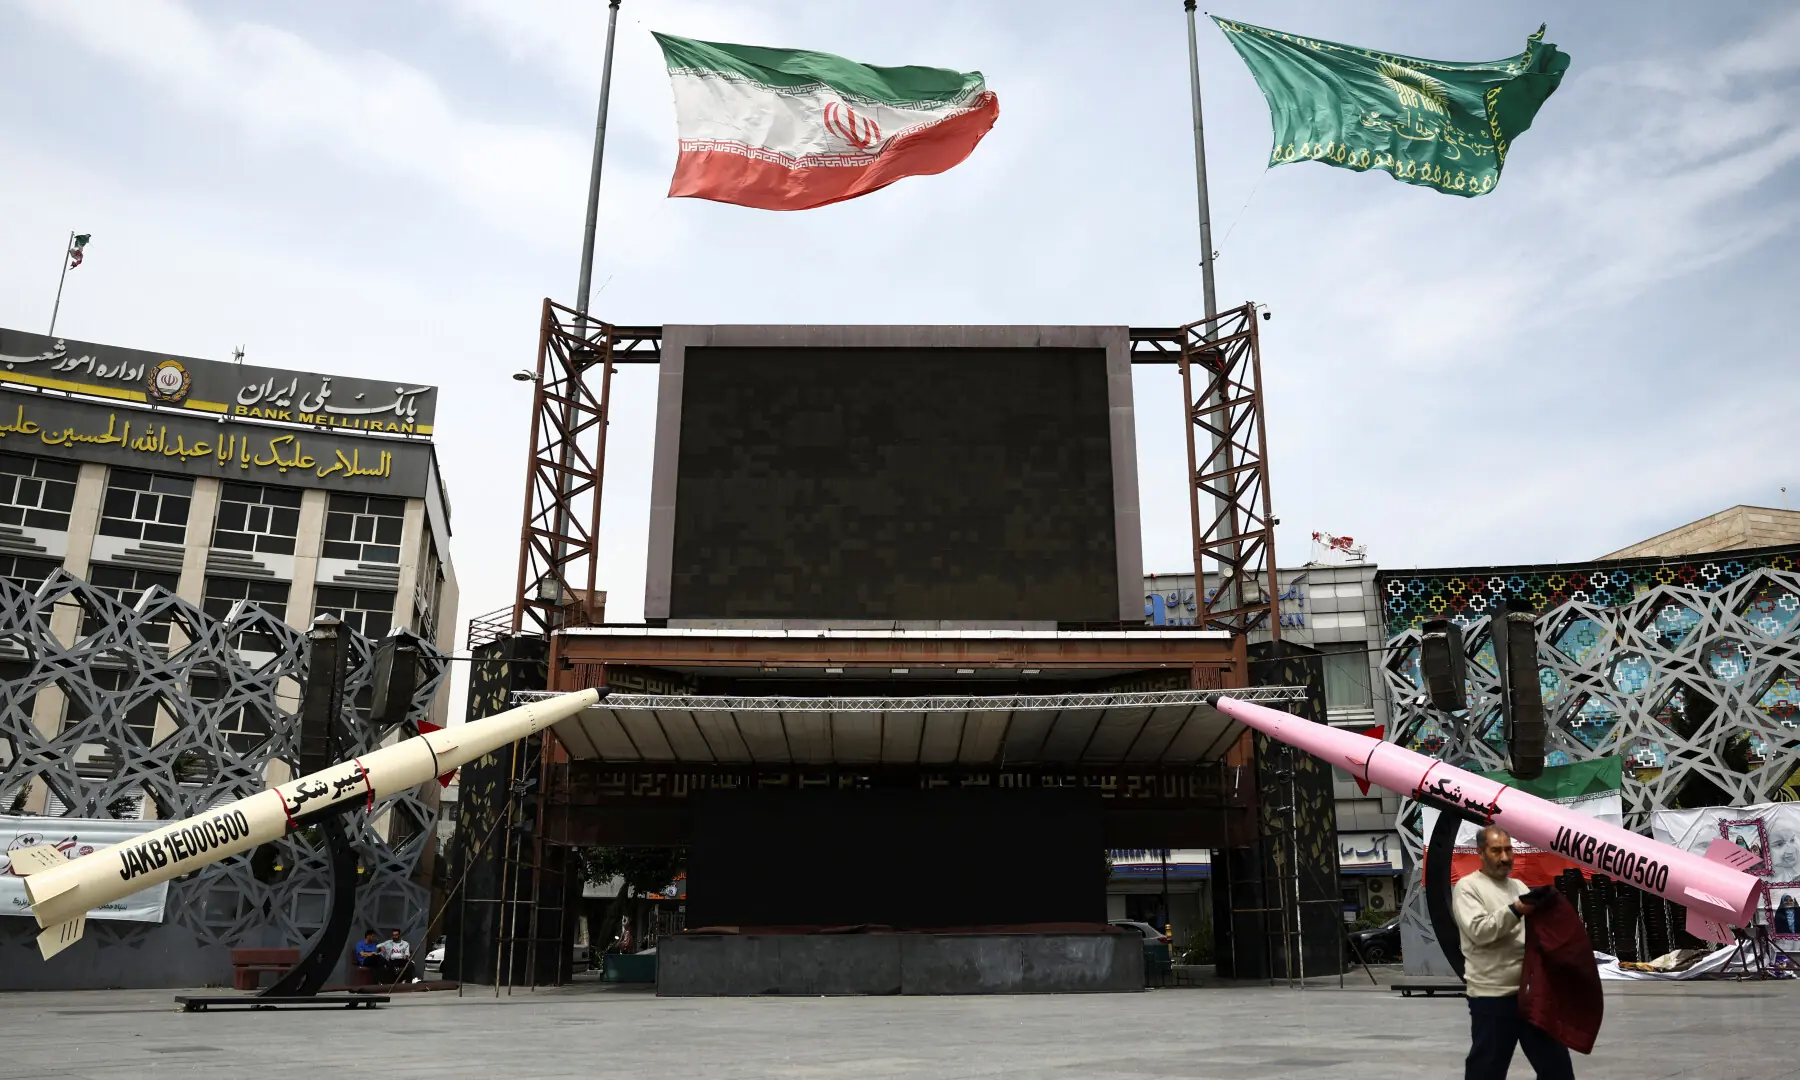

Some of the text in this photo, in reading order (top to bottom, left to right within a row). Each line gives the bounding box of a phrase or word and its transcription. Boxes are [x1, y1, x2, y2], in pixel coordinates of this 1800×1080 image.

[52, 355, 96, 374] امور
[97, 361, 144, 381] اداره
[237, 376, 298, 407] ایران
[324, 386, 431, 423] بانک
[41, 413, 130, 448] الحسین
[235, 405, 414, 433] BANK MELLI IRAN
[240, 436, 251, 469] یا
[254, 434, 316, 473] علیک
[316, 448, 392, 478] السلام
[286, 779, 329, 816] شکن
